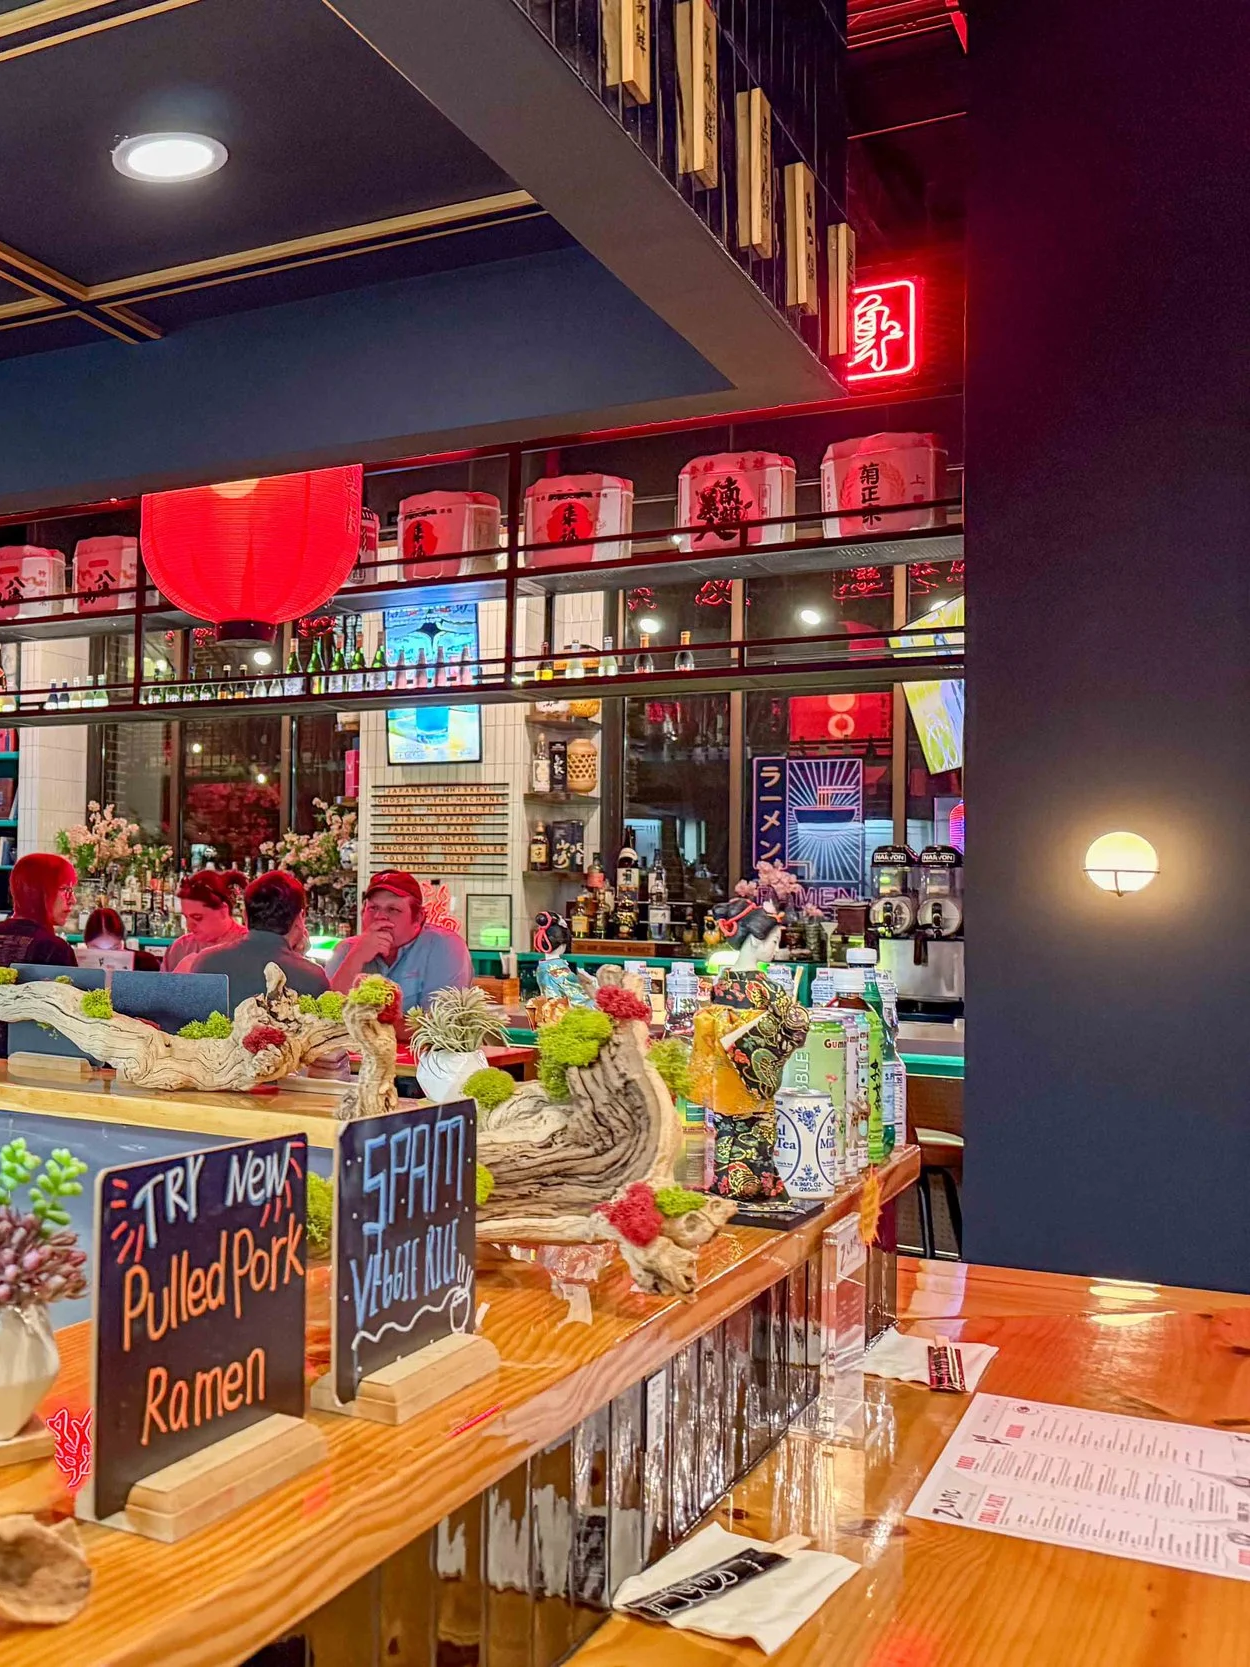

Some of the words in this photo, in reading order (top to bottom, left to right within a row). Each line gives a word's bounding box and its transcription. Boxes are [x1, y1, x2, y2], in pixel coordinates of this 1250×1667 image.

[759, 765, 783, 860] ラーメン
[132, 1154, 204, 1248] TRY
[363, 1115, 464, 1236] SPAM
[124, 1230, 228, 1351] Pulled
[233, 1213, 304, 1319] Pork
[140, 1348, 265, 1445] Ramen
